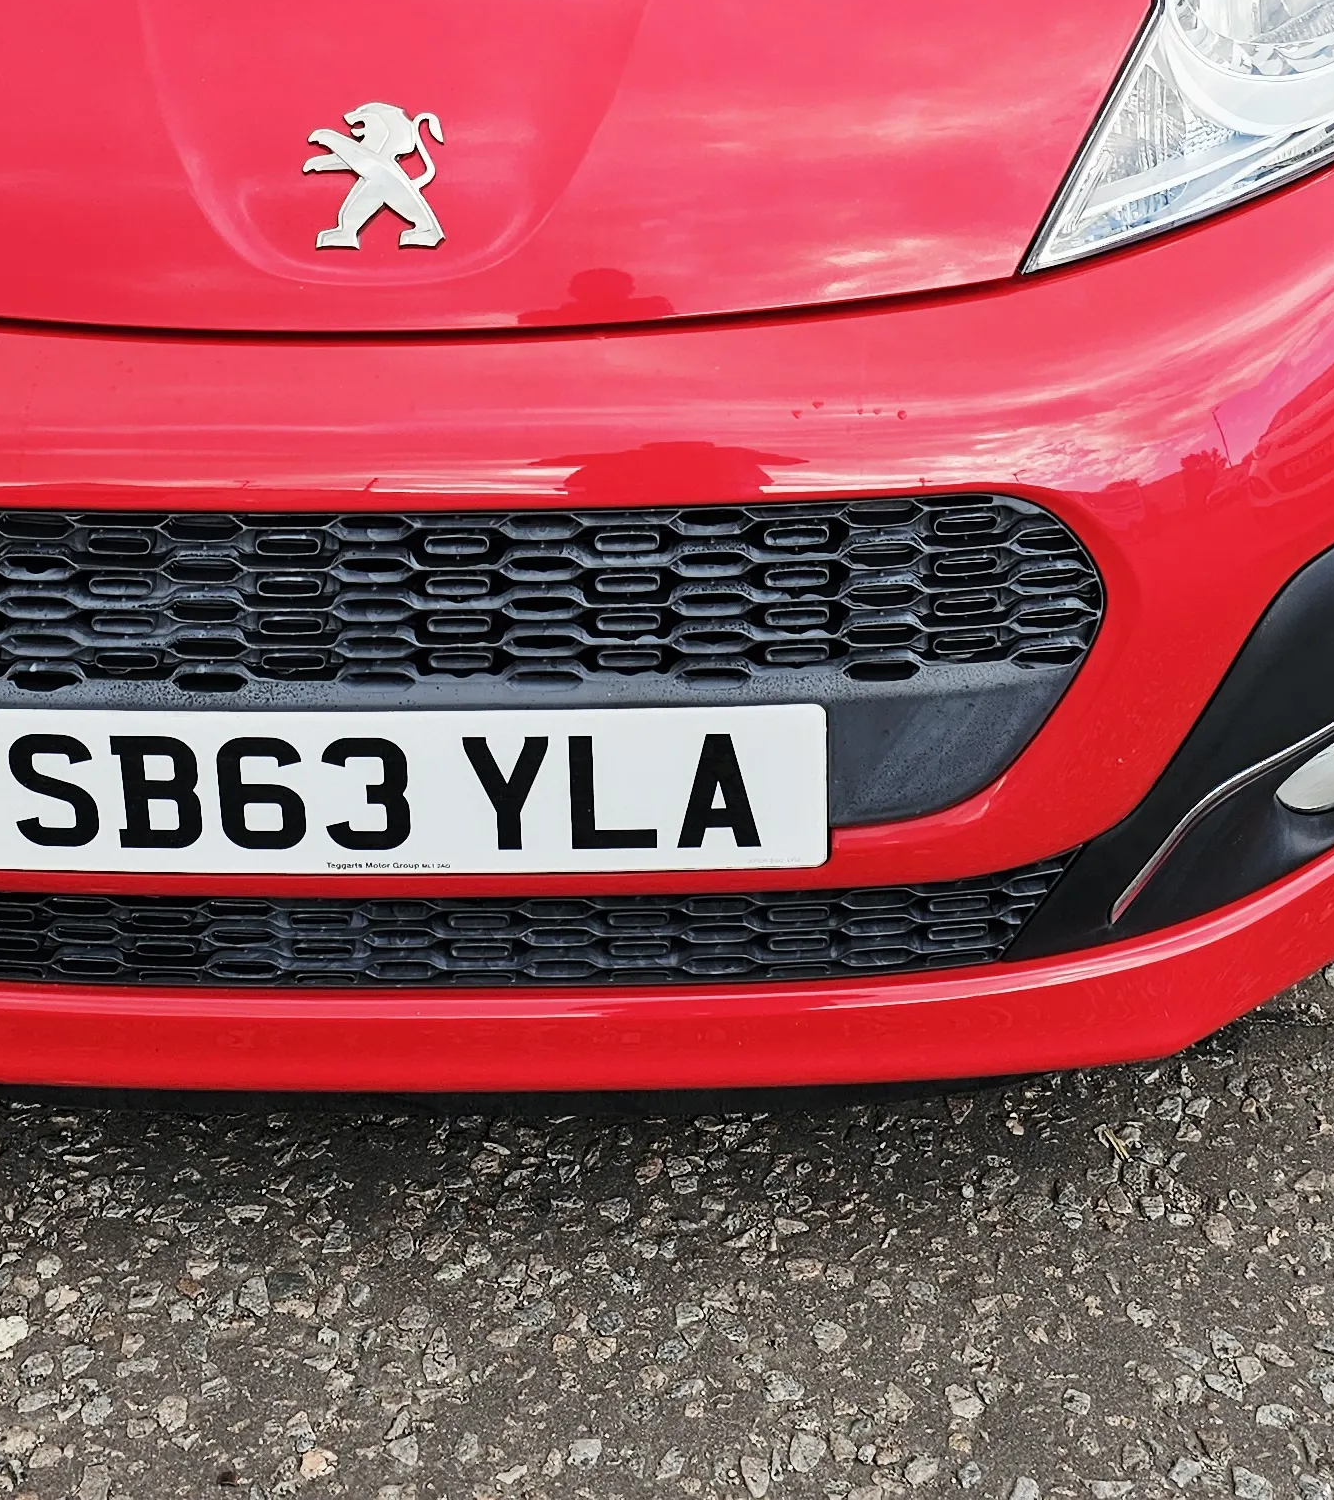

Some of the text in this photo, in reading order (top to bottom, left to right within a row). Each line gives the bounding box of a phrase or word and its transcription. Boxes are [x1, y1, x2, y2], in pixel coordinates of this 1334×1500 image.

[7, 732, 762, 851] SB63 YLA
[365, 861, 390, 869] Motor
[392, 861, 420, 870] Group
